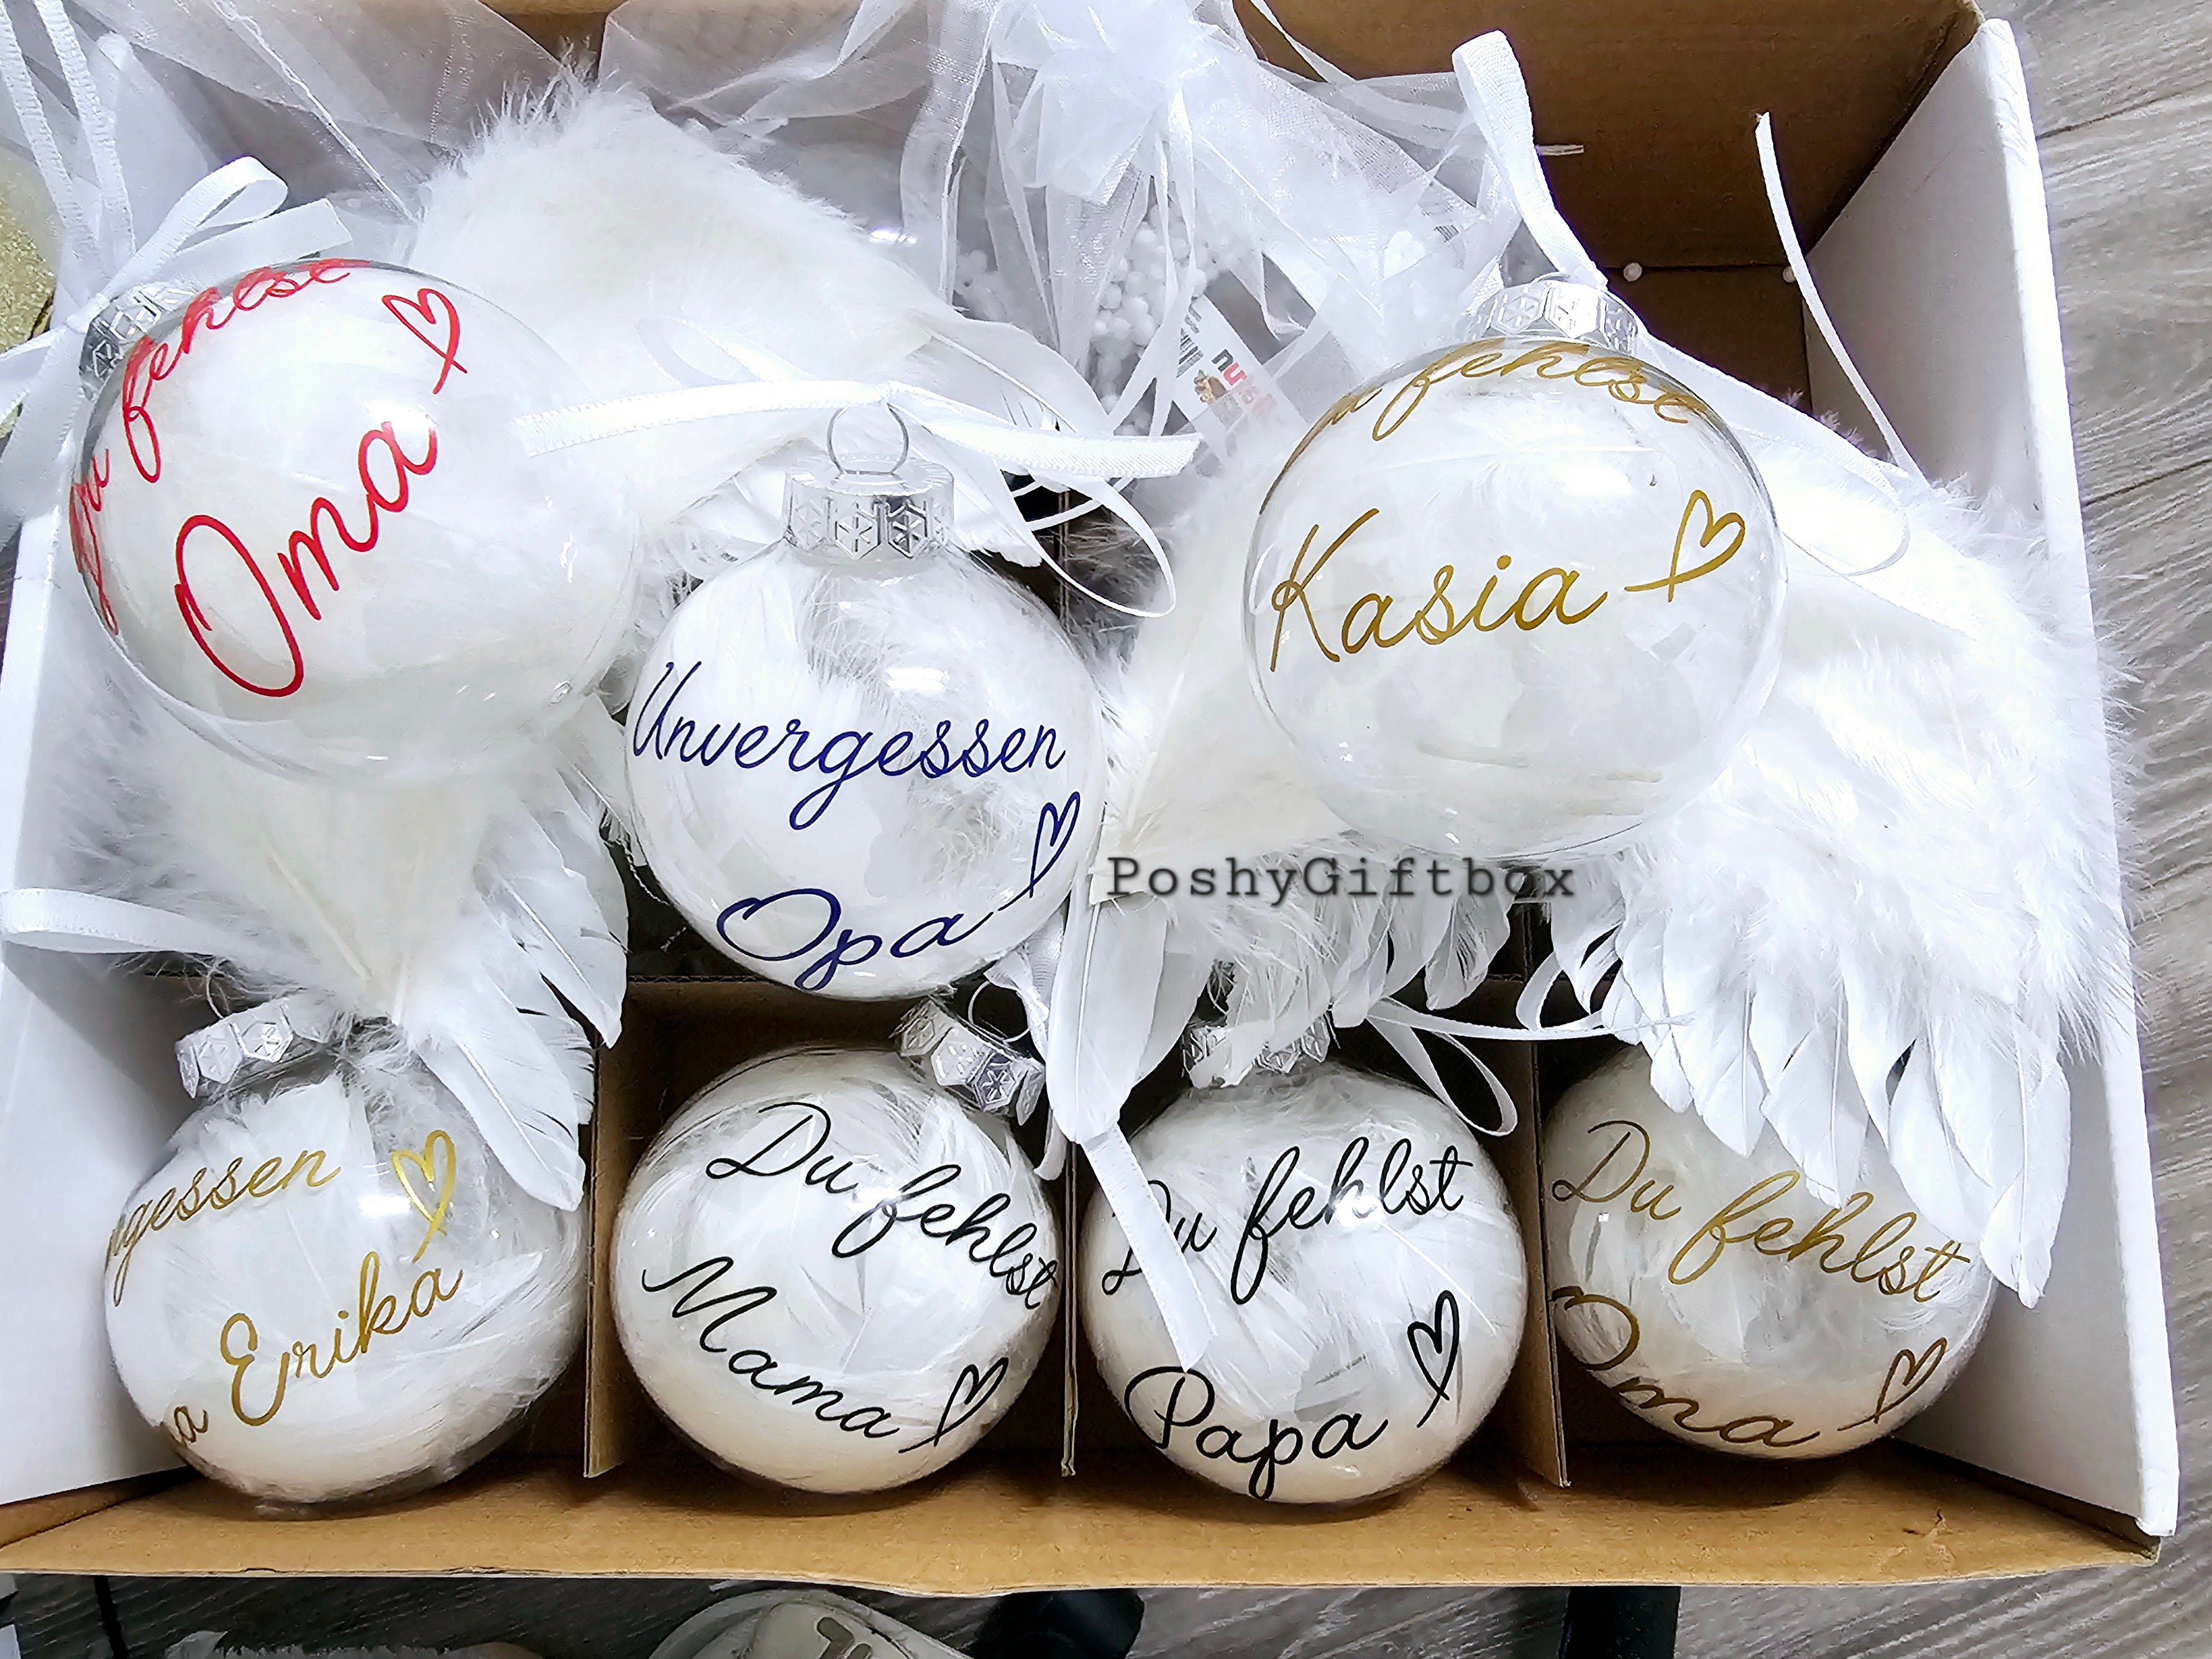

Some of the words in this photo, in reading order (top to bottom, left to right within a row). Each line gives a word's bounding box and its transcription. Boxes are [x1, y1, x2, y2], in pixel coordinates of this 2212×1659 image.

[175, 414, 439, 697] Oma
[1270, 508, 1609, 672] Kasia
[633, 661, 1066, 831] Unvergessen
[716, 888, 994, 990] Opa
[706, 1102, 860, 1193] Du
[832, 1164, 1058, 1310] fehlst
[1230, 1136, 1474, 1305] fehlst
[1552, 1120, 1681, 1220] Du
[1668, 1171, 1971, 1302] fehlst
[219, 1251, 463, 1427] Erika
[642, 1257, 900, 1439] Mama
[1550, 1285, 1821, 1448] Oma
[1123, 1365, 1389, 1501] Papa
